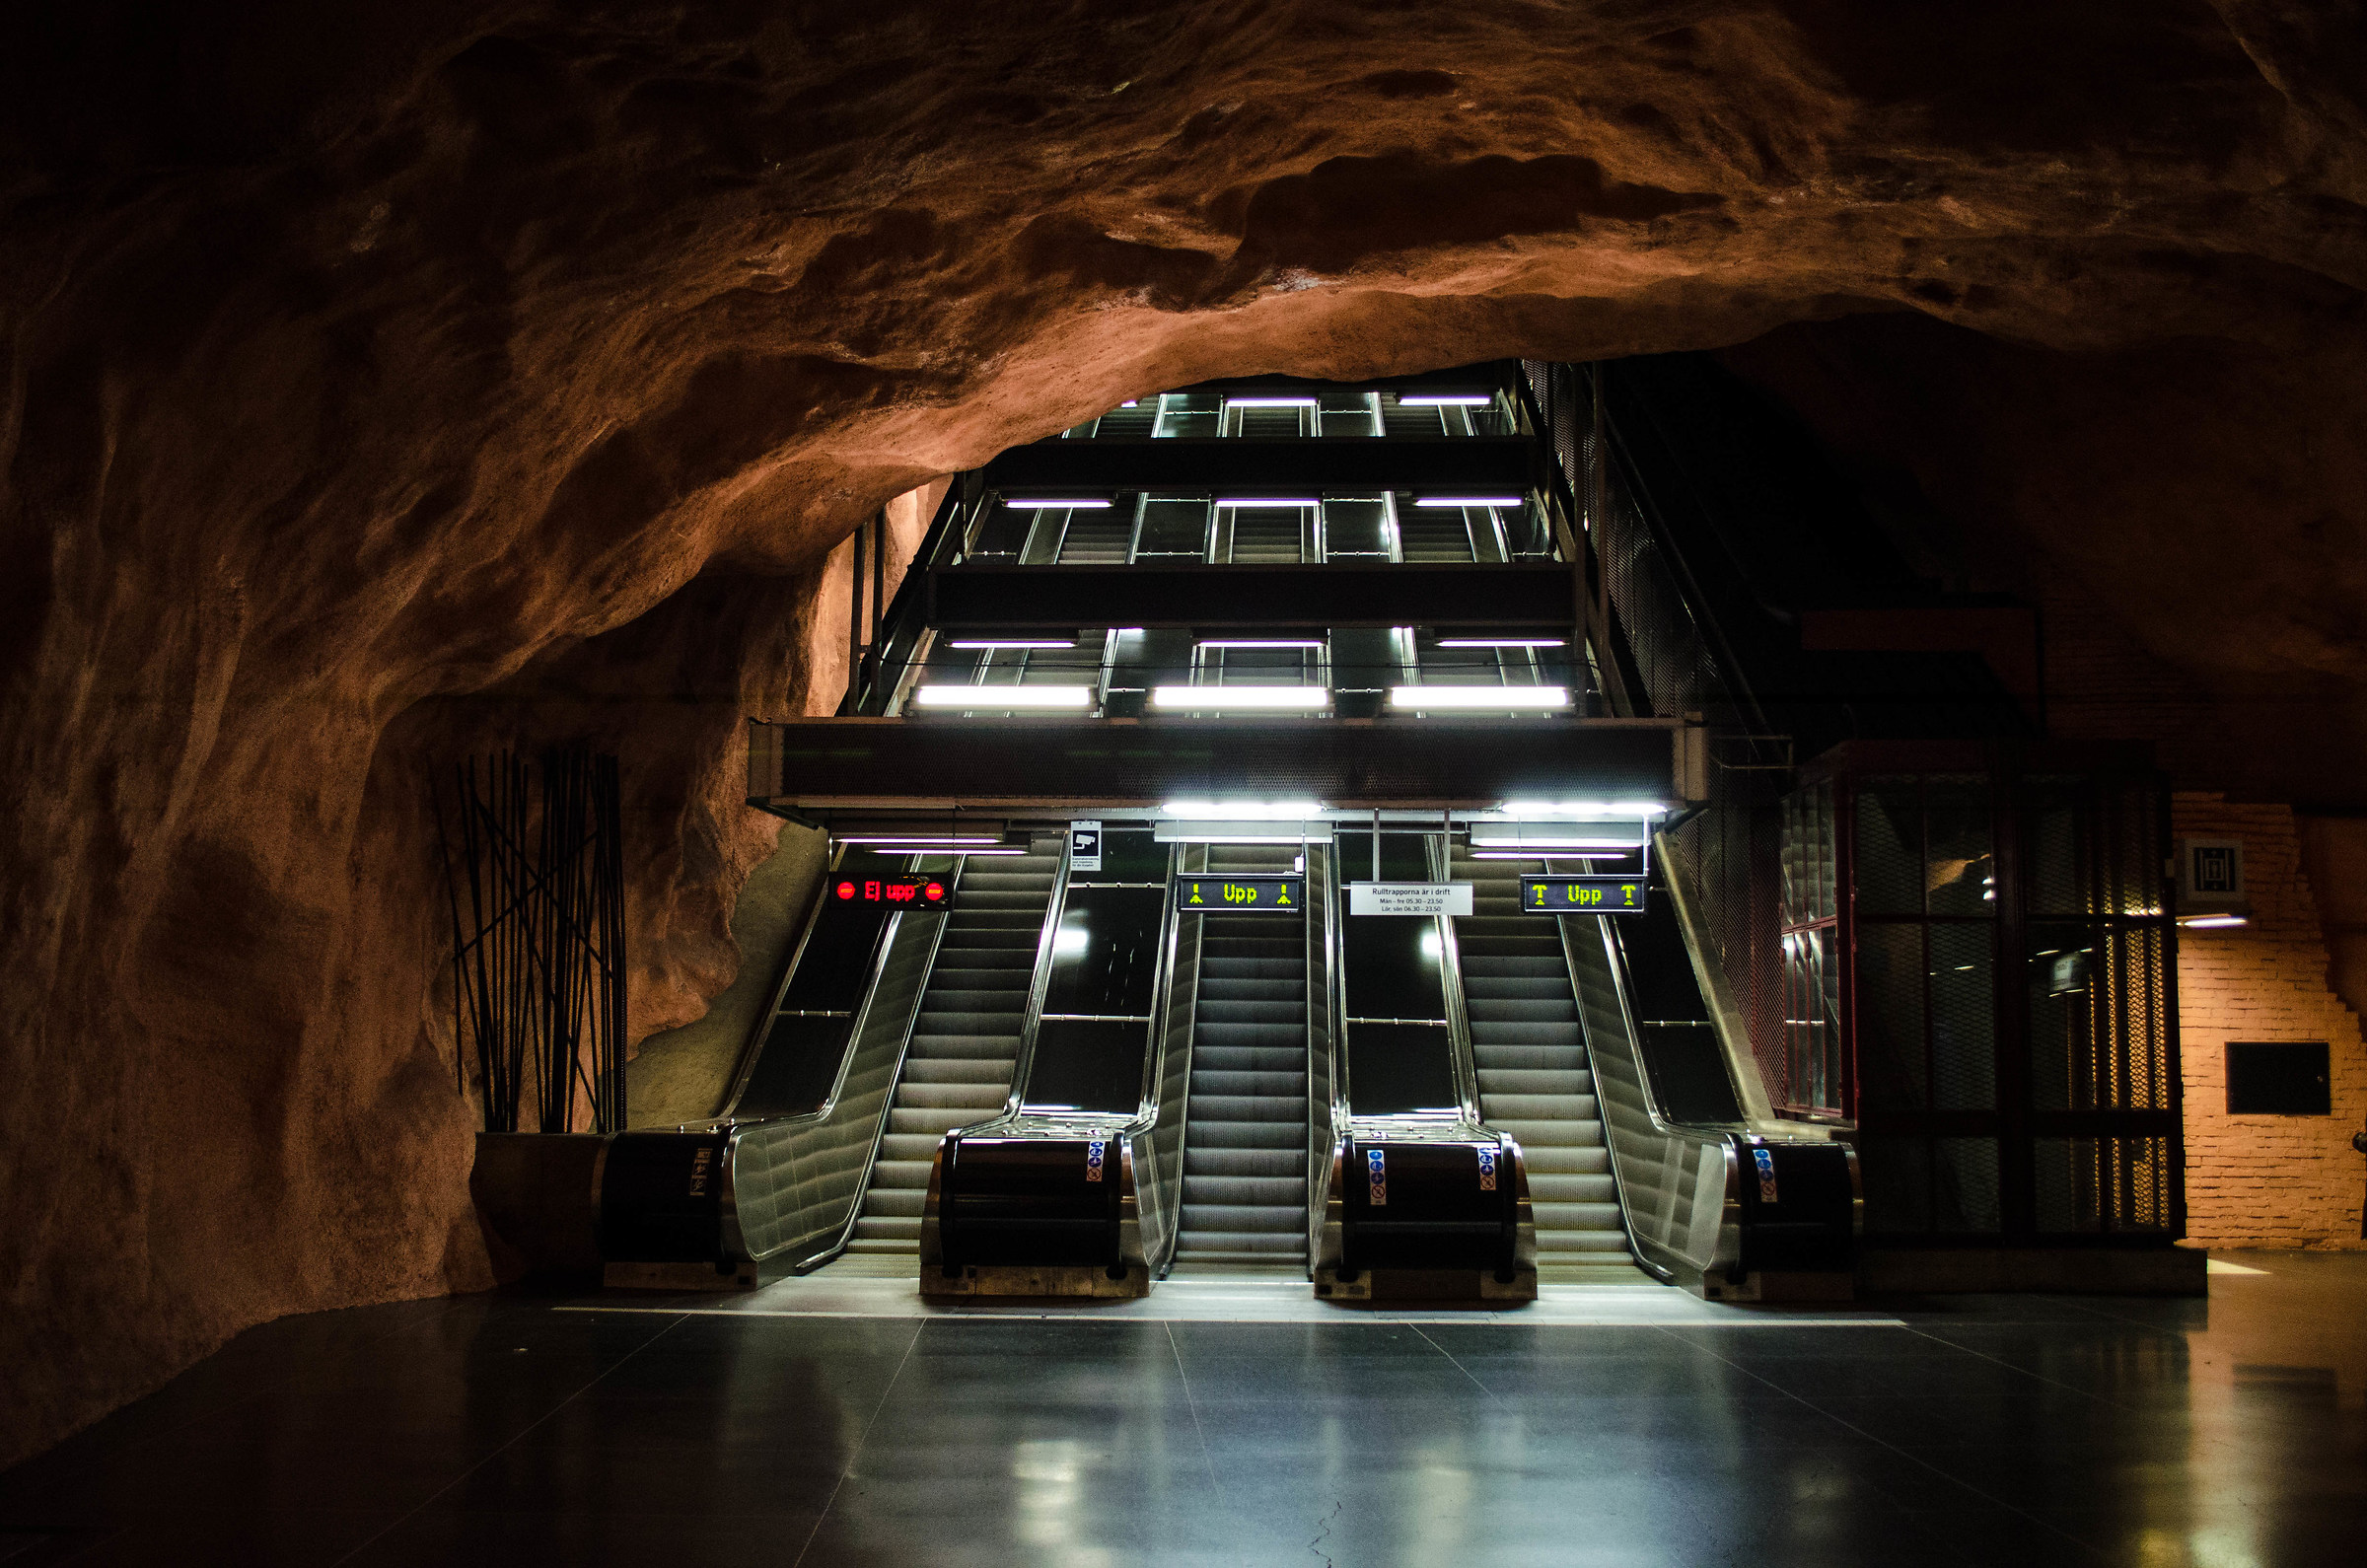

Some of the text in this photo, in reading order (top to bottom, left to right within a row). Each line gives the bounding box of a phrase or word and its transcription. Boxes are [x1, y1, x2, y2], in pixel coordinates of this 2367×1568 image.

[865, 881, 915, 901] Ej upp
[1224, 884, 1257, 903] Upp
[1567, 885, 1602, 905] Upp
